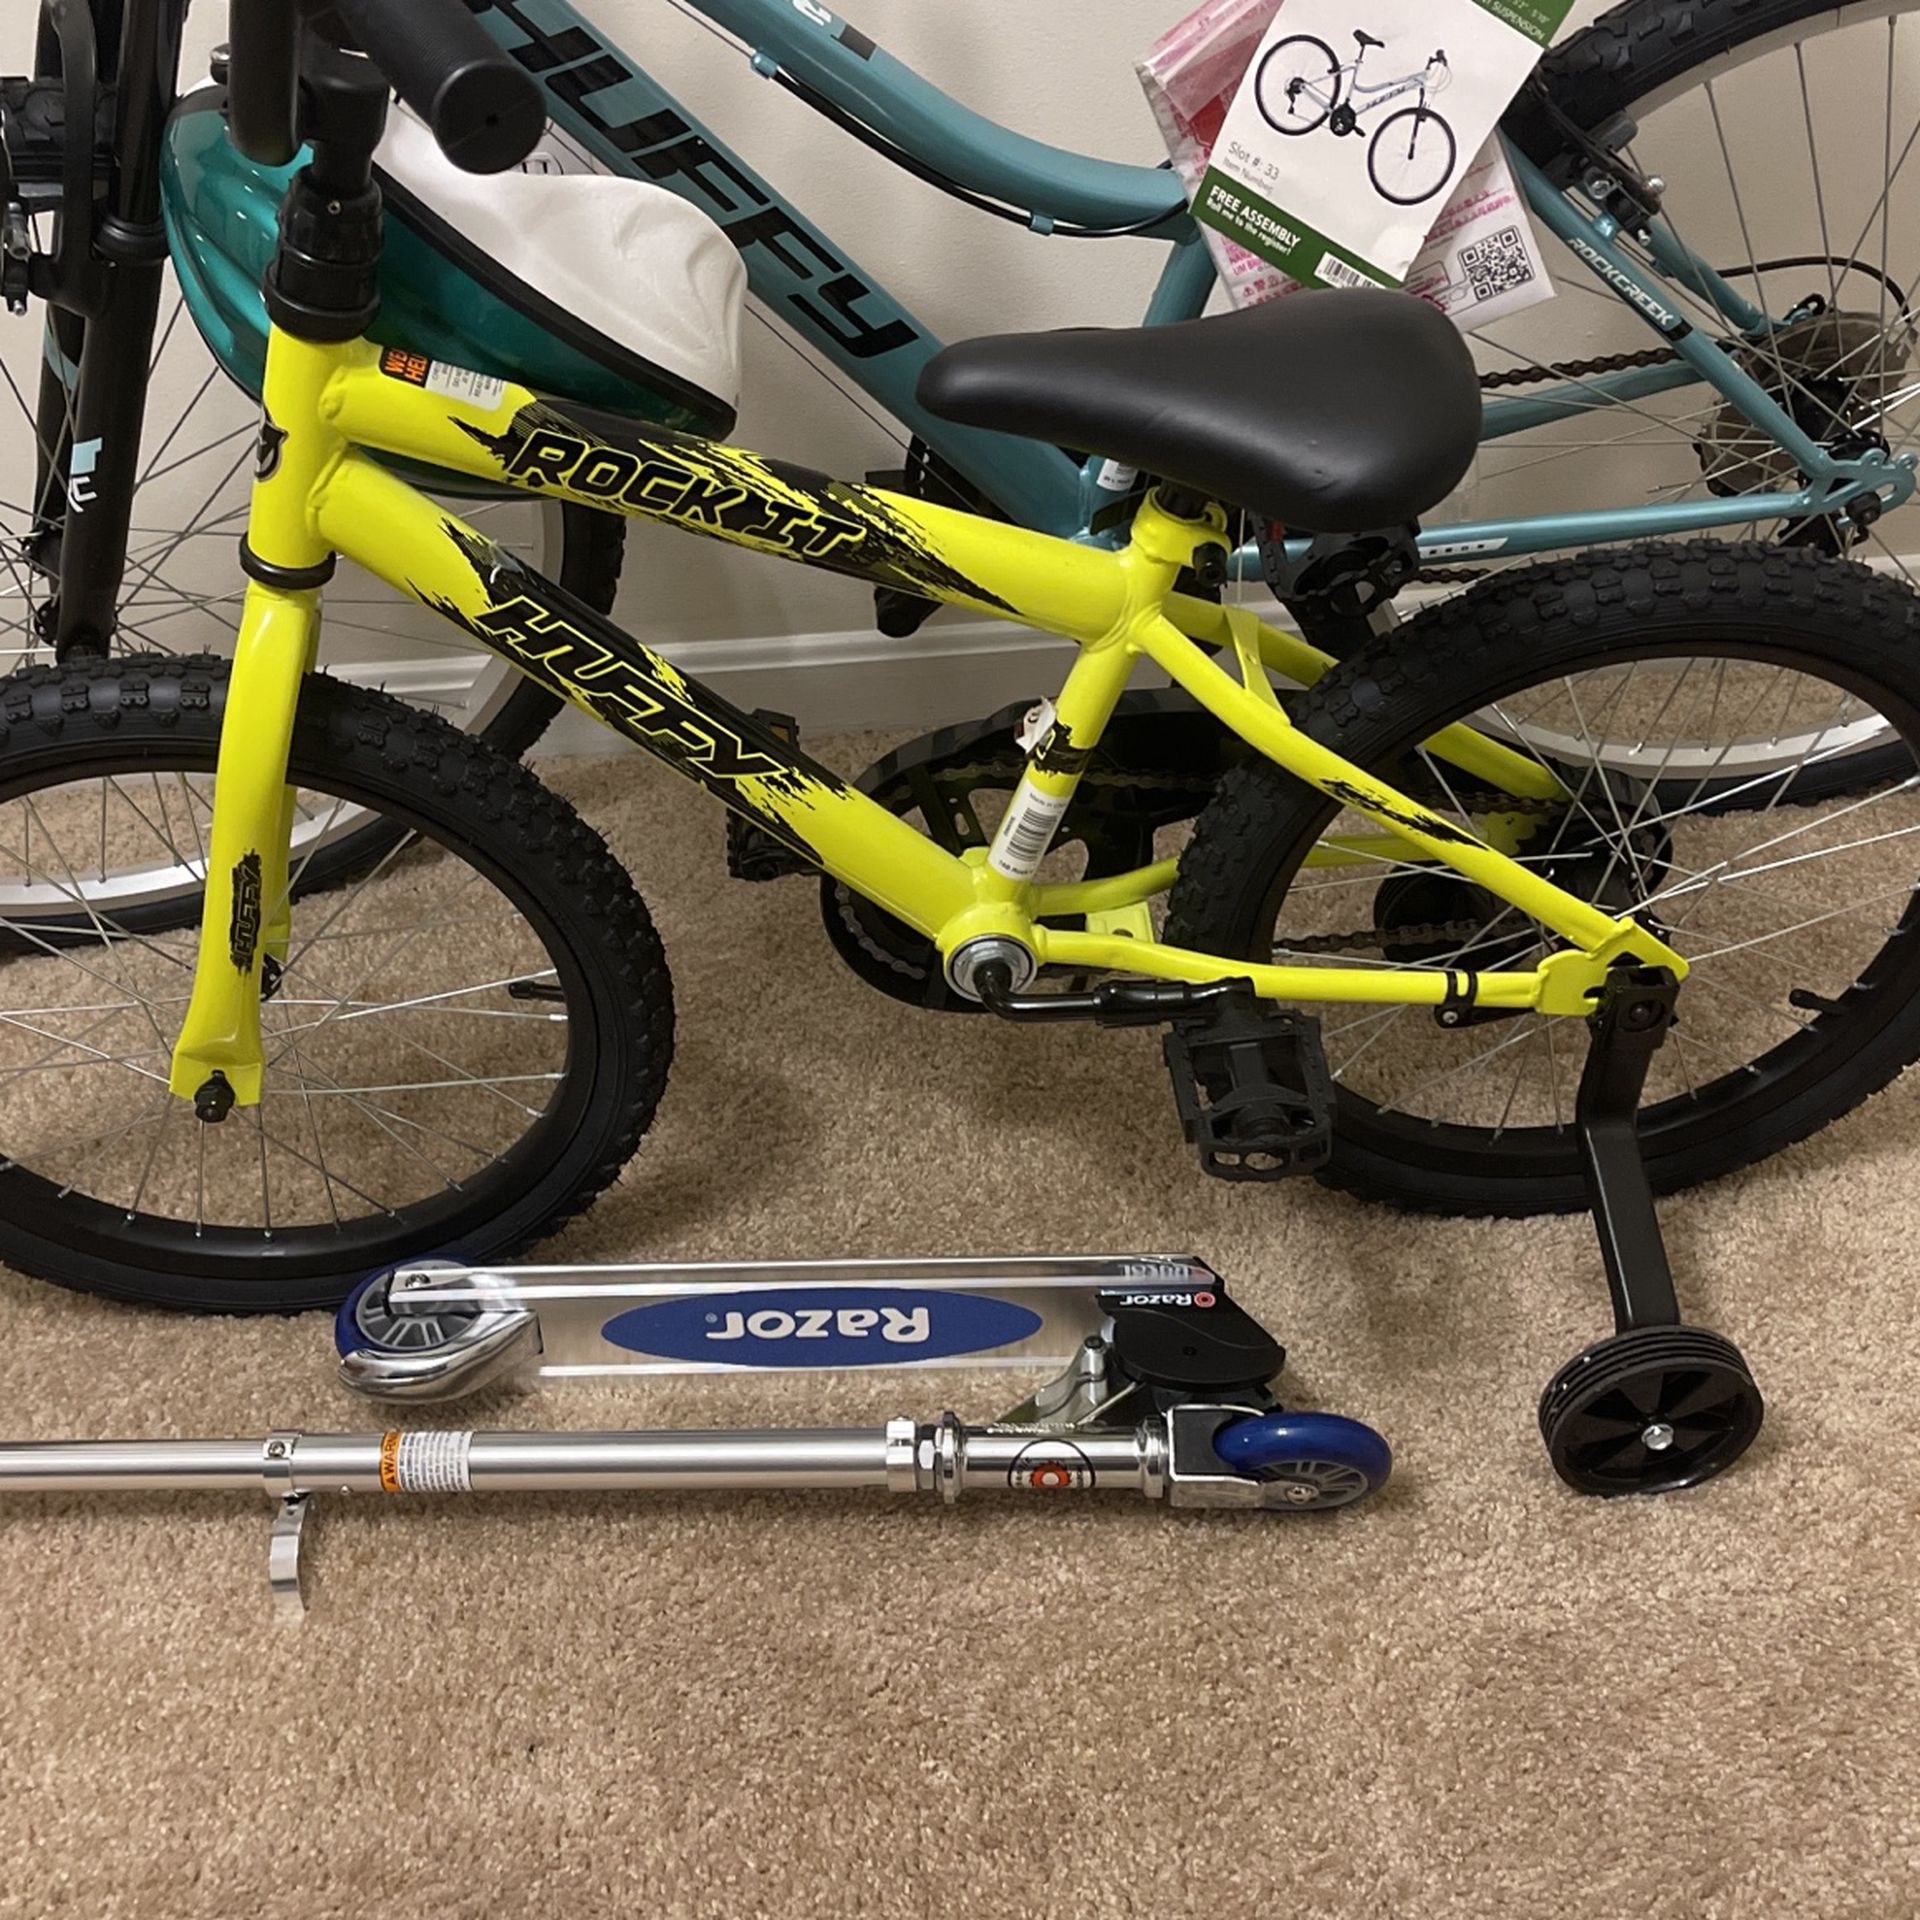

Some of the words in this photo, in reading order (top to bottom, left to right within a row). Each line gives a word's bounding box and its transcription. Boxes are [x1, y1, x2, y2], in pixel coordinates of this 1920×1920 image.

[462, 0, 919, 358] HUFFY
[1228, 141, 1251, 163] Slot
[1263, 163, 1280, 180] 33
[1206, 196, 1222, 213] Roll
[1221, 209, 1235, 221] me
[1235, 215, 1244, 227] to
[1244, 222, 1258, 235] the
[1258, 231, 1292, 256] register!
[1210, 184, 1242, 212] FREE
[1240, 205, 1301, 248] ASSEMBLY
[1567, 237, 1675, 326] ROCKCREEK
[503, 428, 750, 532] ROCK
[755, 506, 867, 557] IT
[473, 594, 790, 779] HUFFY
[234, 862, 261, 957] HUFFY
[705, 1306, 930, 1343] Razor
[1120, 1292, 1192, 1306] Razor
